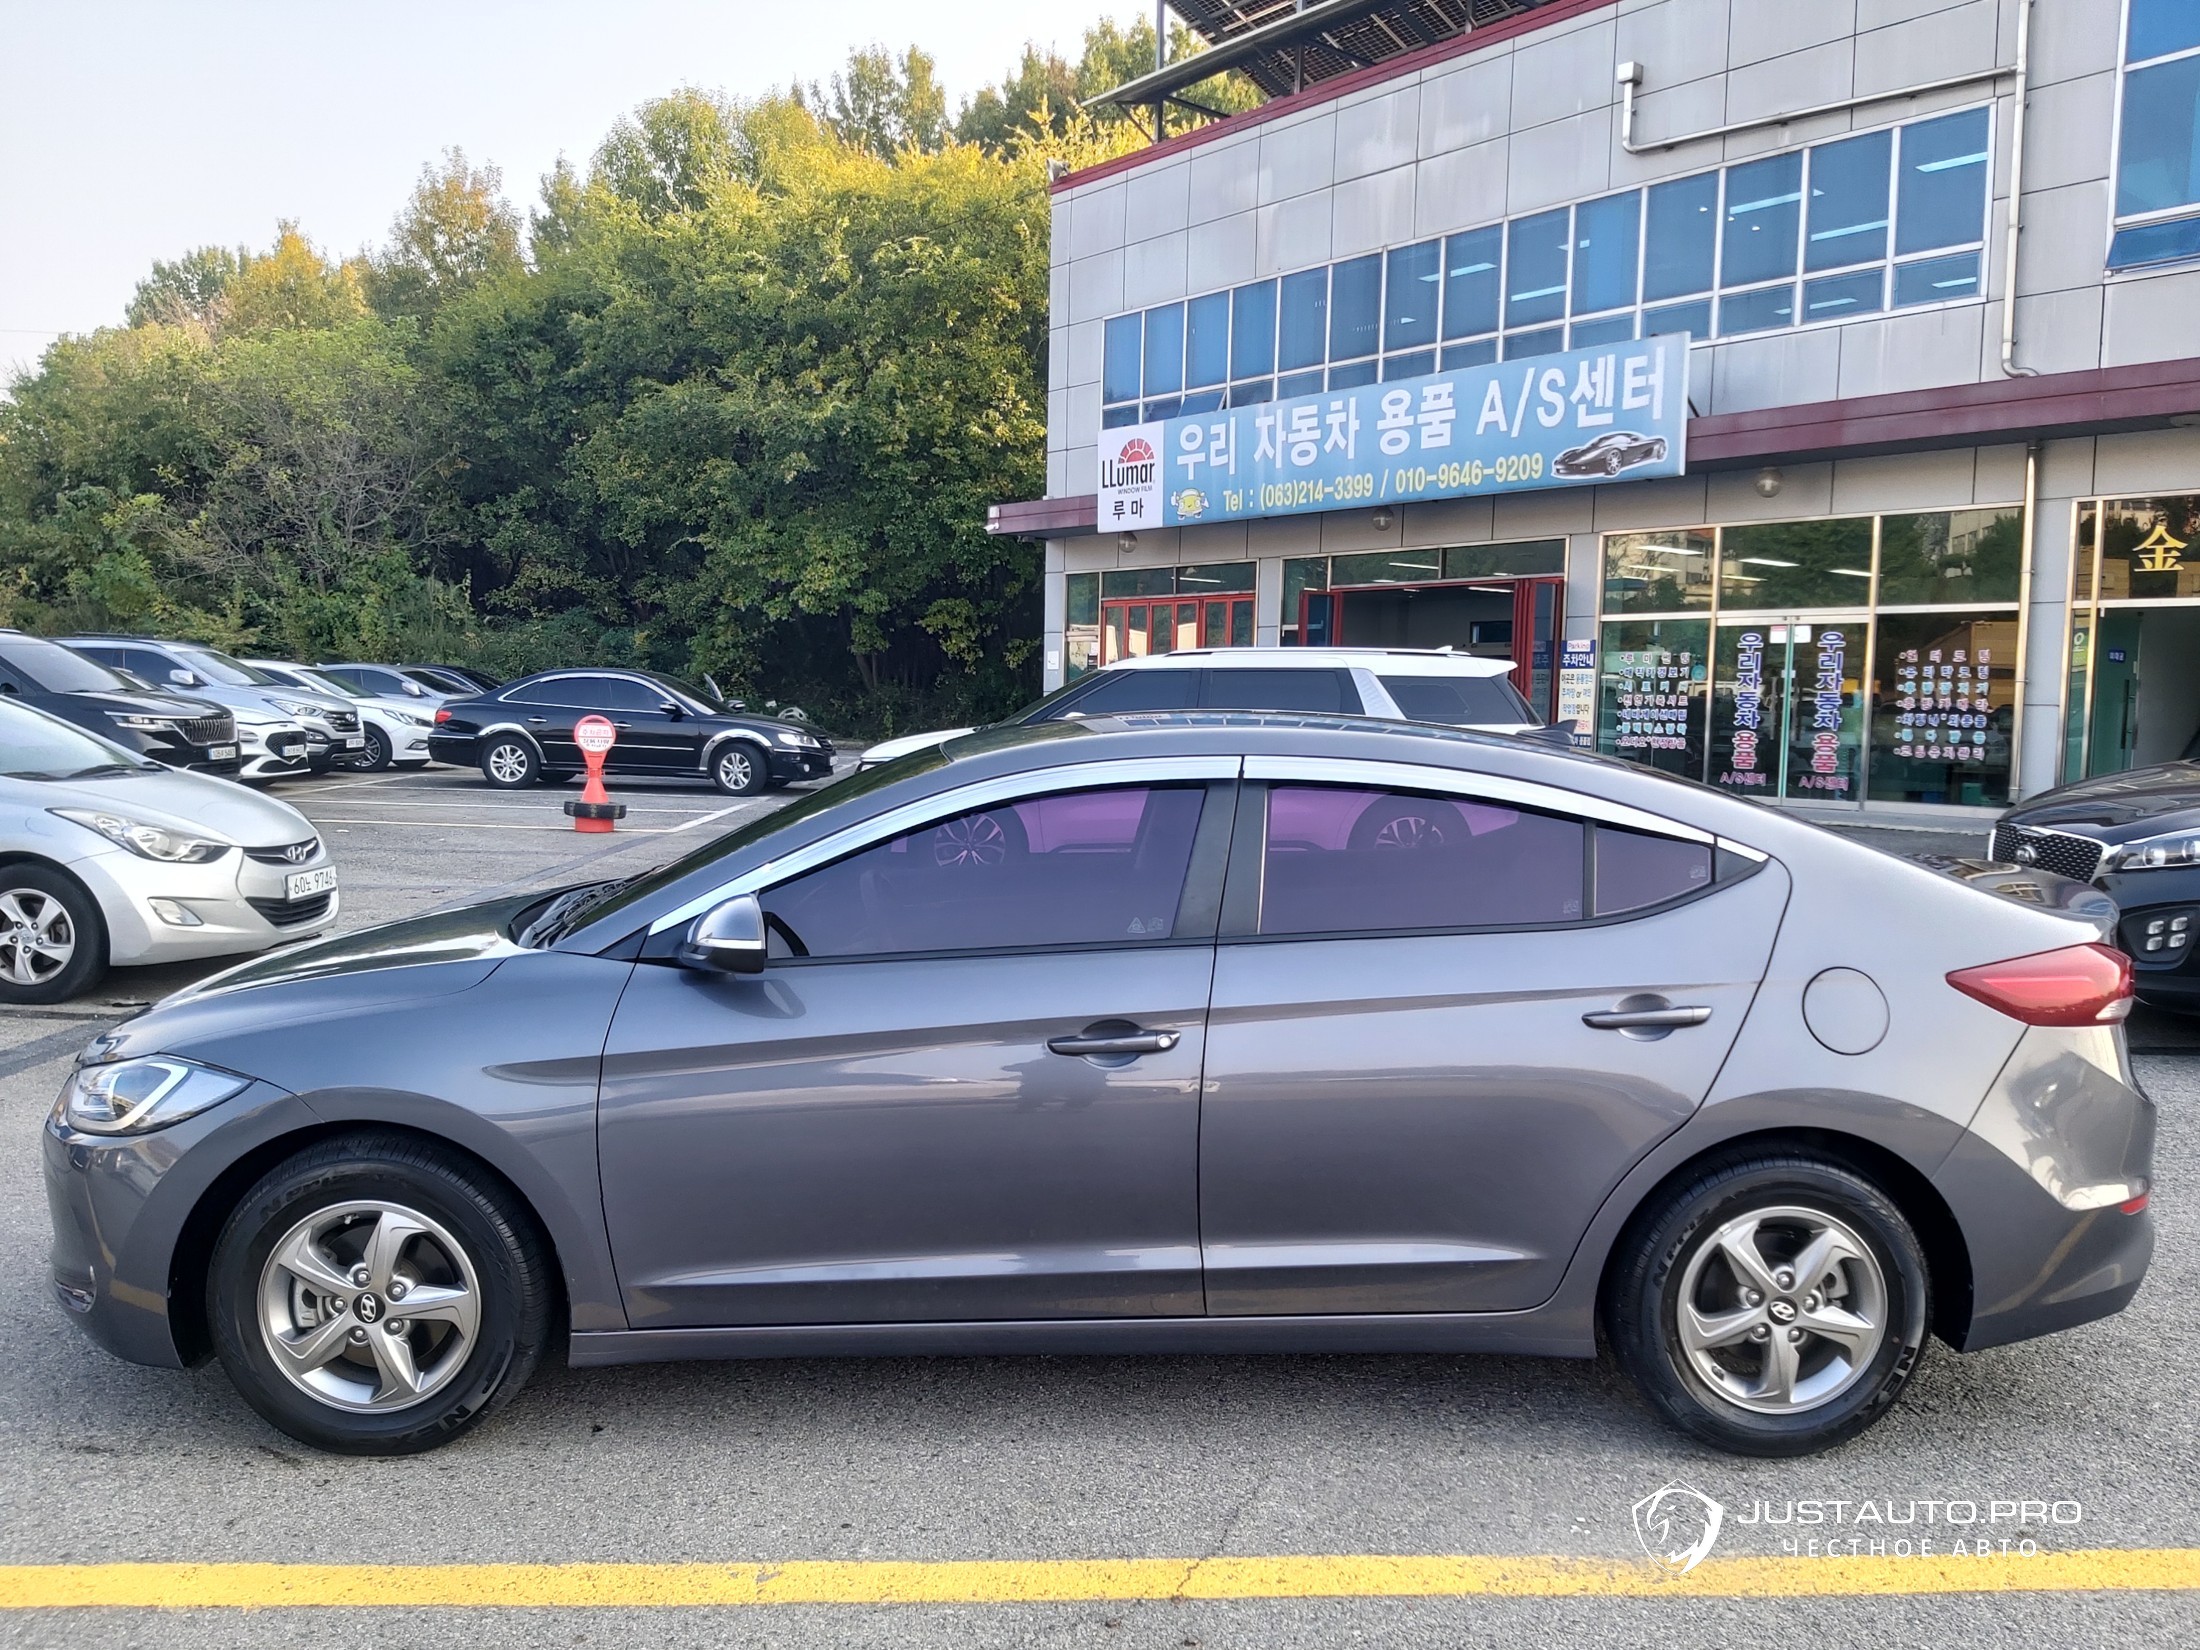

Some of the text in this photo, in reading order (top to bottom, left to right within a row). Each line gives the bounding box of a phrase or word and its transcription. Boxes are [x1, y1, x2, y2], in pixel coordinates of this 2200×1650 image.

[1177, 347, 1666, 480] 우리 자동차 용품 A/S센터
[1102, 459, 1155, 489] LLumar
[1118, 486, 1140, 495] WINDOW
[1223, 488, 1243, 512] Tel
[1260, 472, 1374, 511] (063)214-3399
[1395, 452, 1544, 495] 010-9646-9209
[2132, 525, 2188, 572] 金
[1562, 653, 1594, 667] 주차안내
[1732, 730, 1759, 769] 용품
[1811, 733, 1840, 773] 용품
